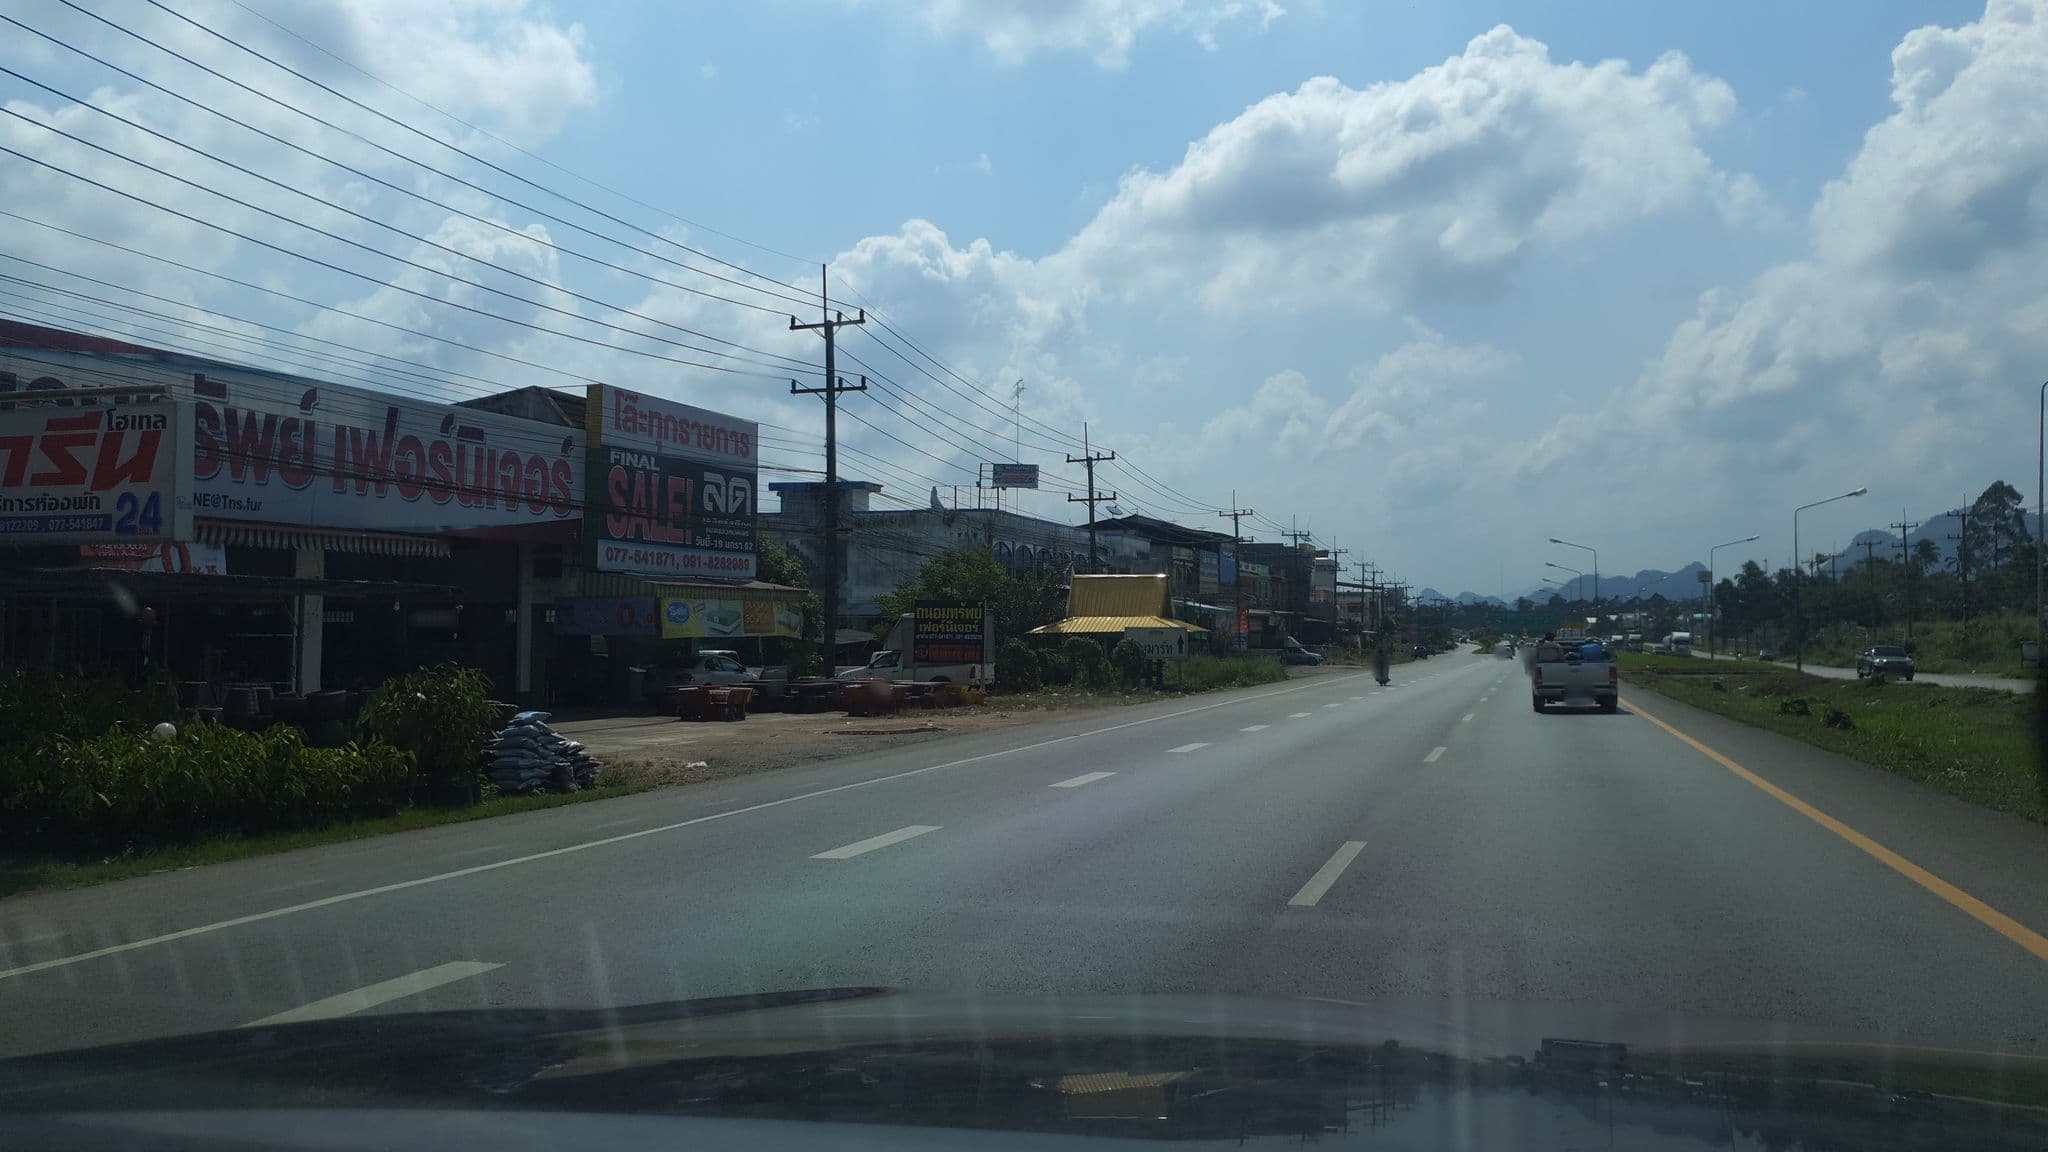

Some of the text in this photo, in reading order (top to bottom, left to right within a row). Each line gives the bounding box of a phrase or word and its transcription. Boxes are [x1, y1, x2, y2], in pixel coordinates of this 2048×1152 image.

[106, 407, 168, 431] โฮเทล
[333, 406, 575, 517] เฟอร์นิเจอร์
[609, 449, 661, 471] FINAL
[193, 492, 264, 512] NE@Tns.fur
[606, 464, 693, 545] SALE!
[703, 471, 751, 516] ลด
[114, 490, 163, 536] 24
[916, 601, 983, 620] ถนอมทรัพย์
[919, 619, 979, 633] เฟอร์นิเจอร์
